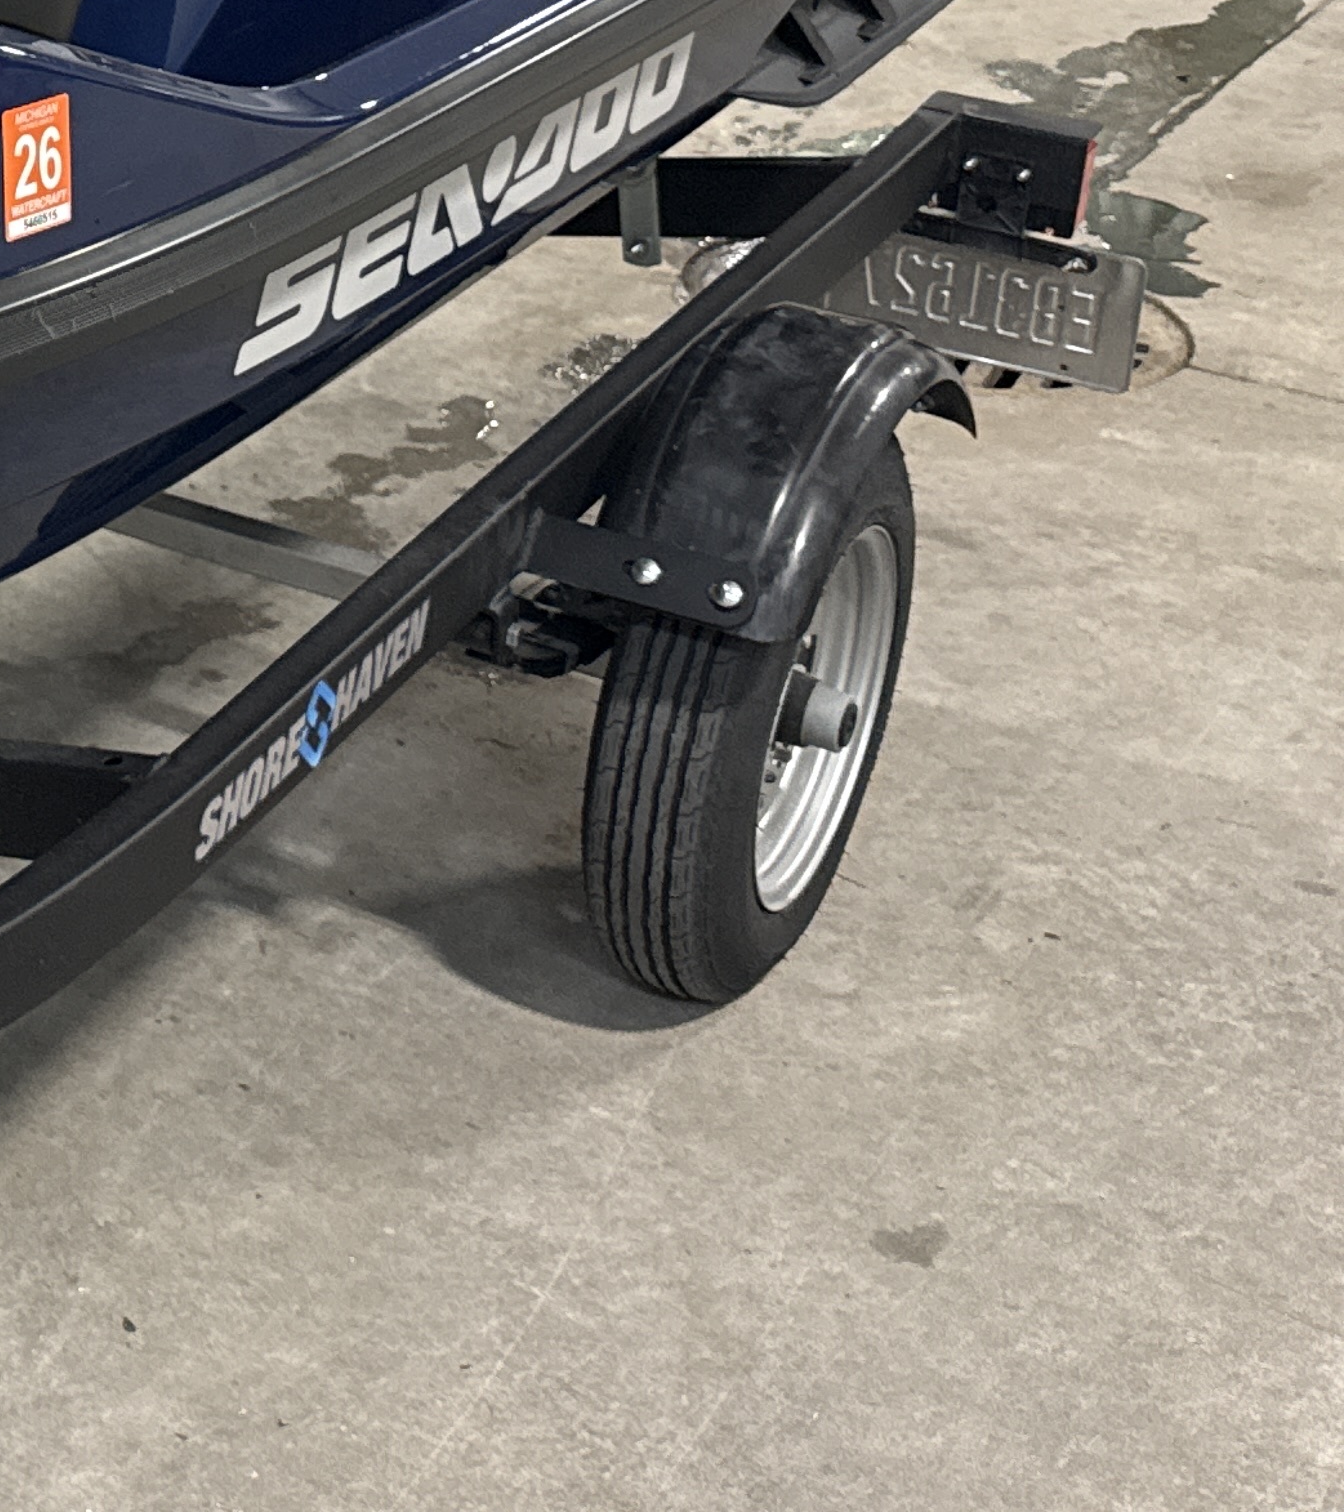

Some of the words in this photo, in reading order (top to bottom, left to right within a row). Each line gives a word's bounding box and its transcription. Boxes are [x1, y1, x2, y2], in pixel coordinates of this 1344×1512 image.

[14, 125, 63, 200] 26
[194, 712, 309, 862] SHORE
[331, 595, 431, 733] HAVEN
